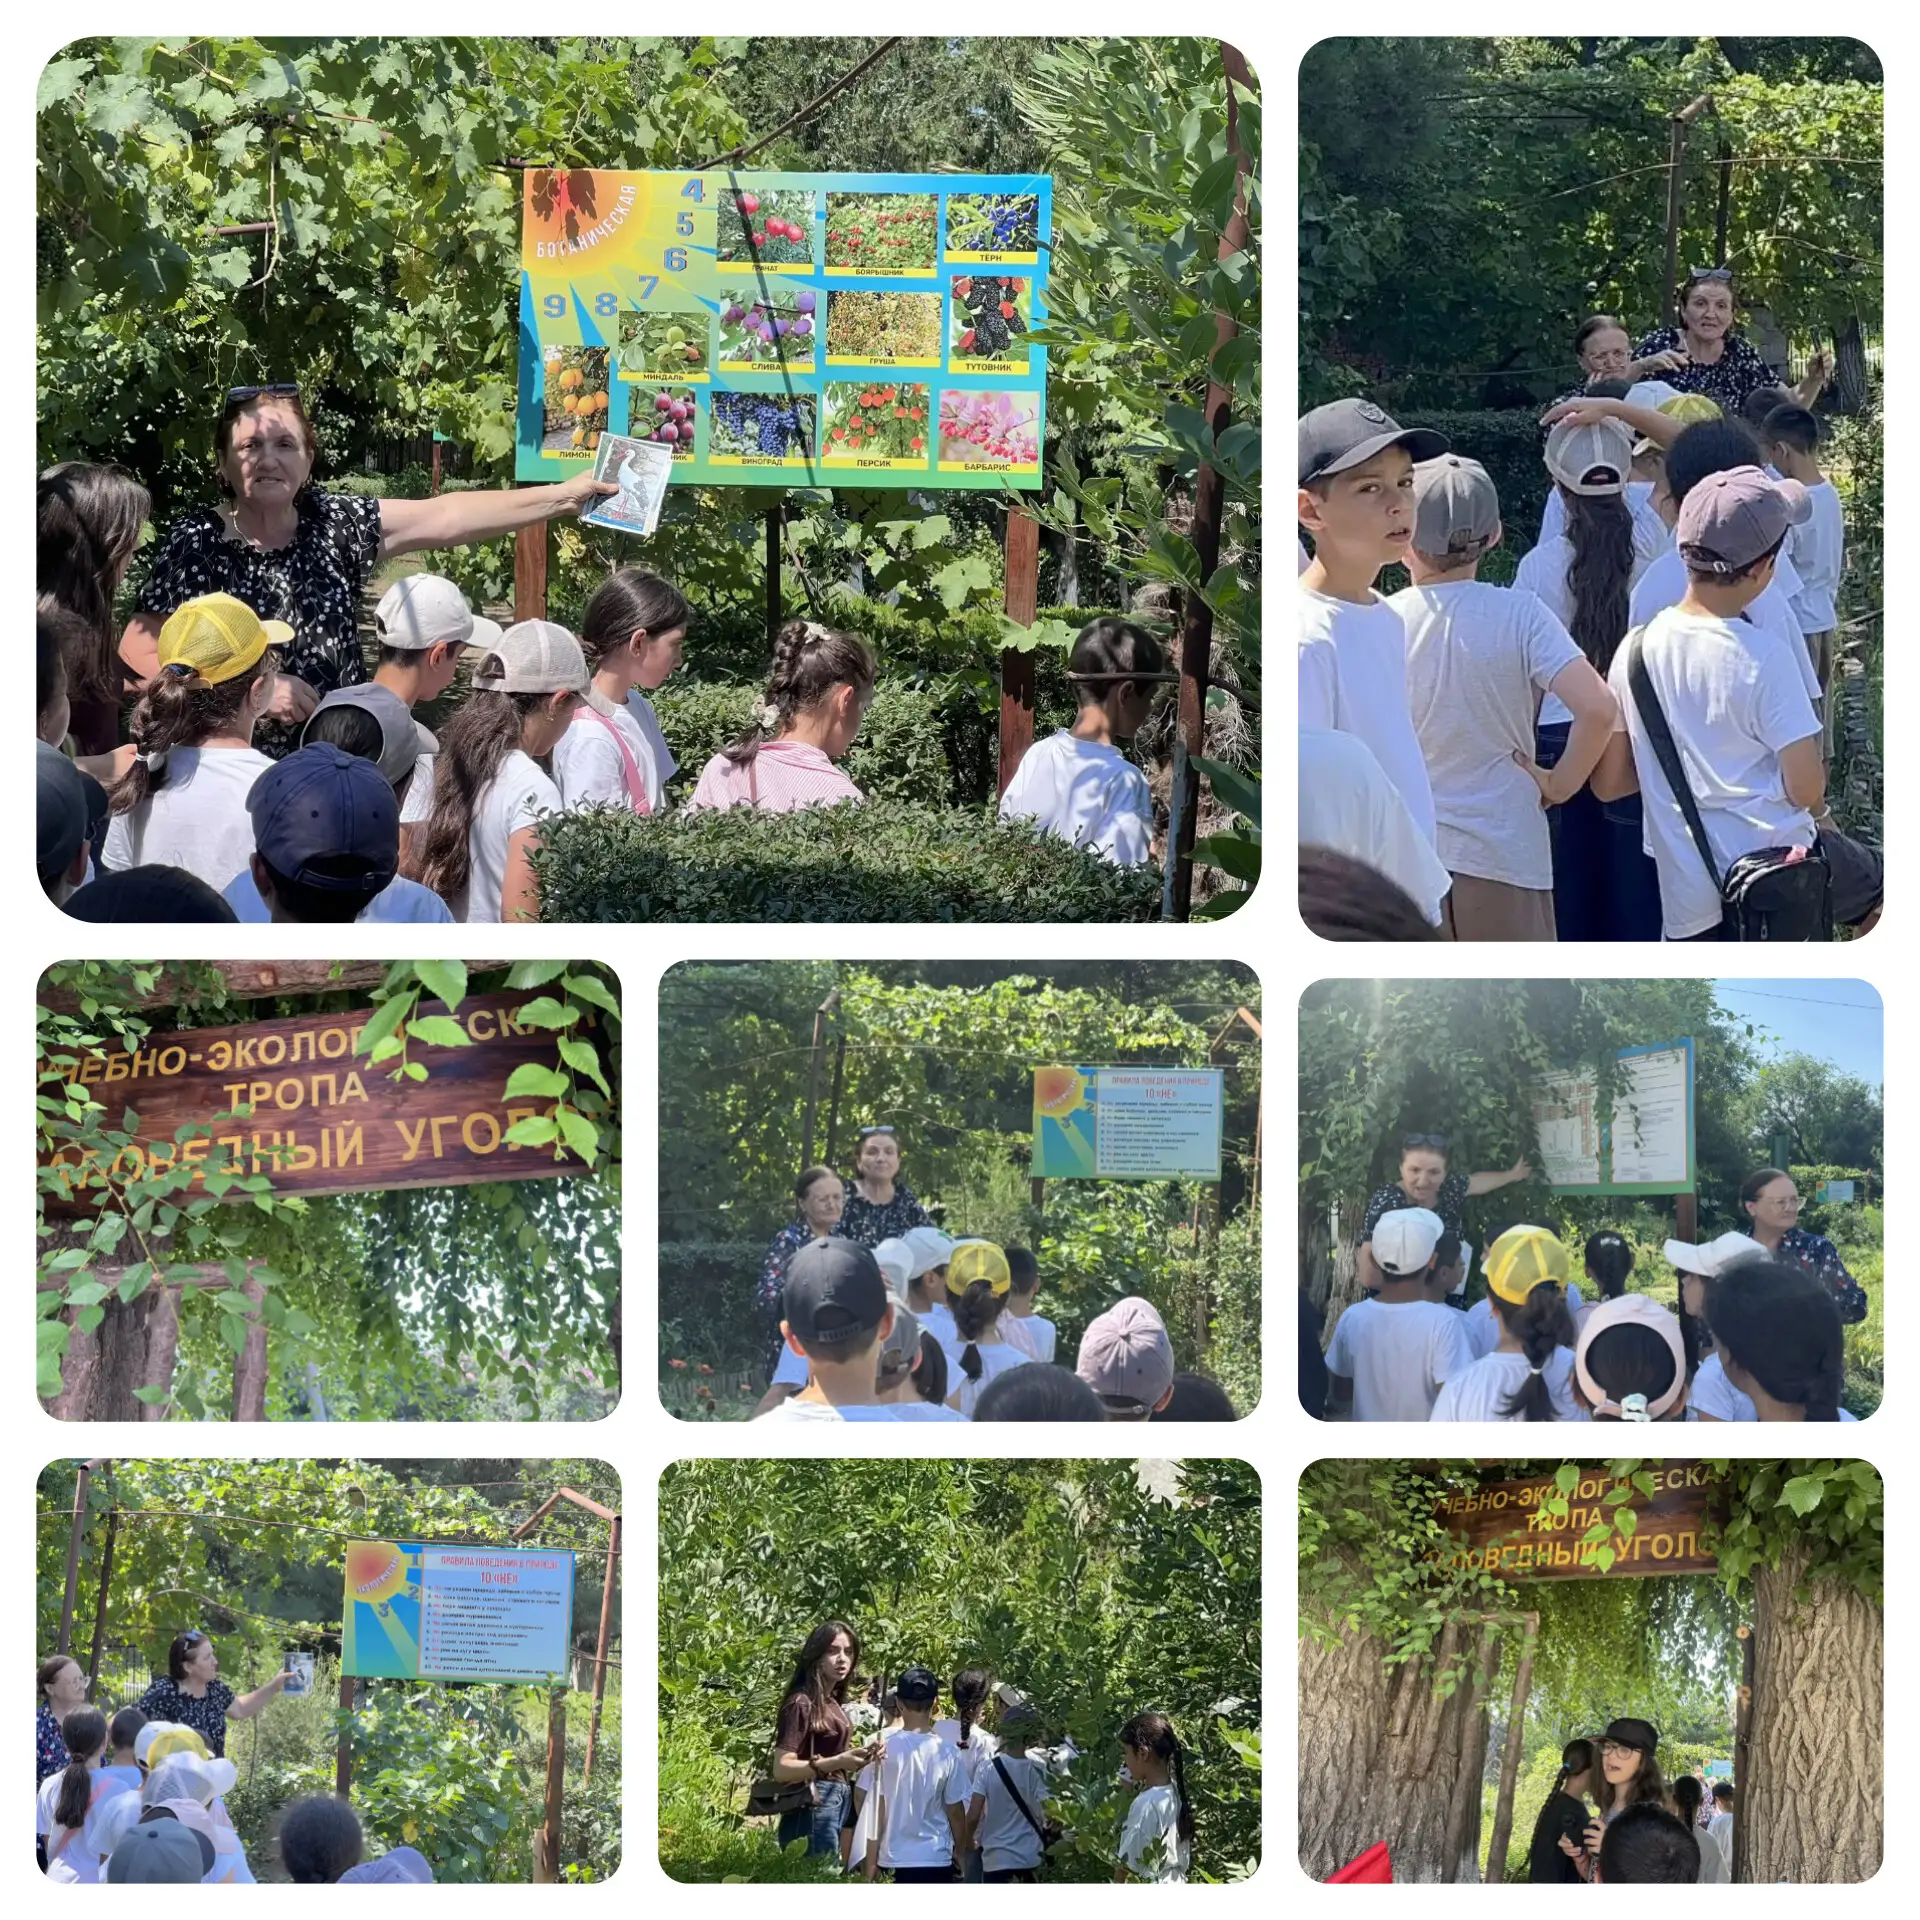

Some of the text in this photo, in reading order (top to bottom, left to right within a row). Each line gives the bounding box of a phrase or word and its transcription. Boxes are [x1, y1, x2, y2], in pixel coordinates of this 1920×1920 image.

[680, 178, 706, 203] 4
[536, 184, 637, 259] БОТАНИЧЕСКАЯ
[676, 212, 694, 237] 5
[663, 247, 688, 272] 6
[979, 254, 1002, 262] ТЕРН
[855, 268, 905, 277] БОЯРЫШНИК
[638, 275, 660, 300] 7
[543, 294, 567, 319] 9
[595, 293, 618, 317] 8
[751, 362, 781, 371] СЛИВА
[869, 357, 896, 366] ГРУША
[965, 363, 1012, 372] ТУТОВНИК
[643, 373, 684, 382] МИНДАЛЬ
[558, 451, 591, 459] ЛИМОН
[741, 458, 783, 467] ВИНОГРАД
[856, 459, 892, 467] ПЕРСИК
[964, 463, 1011, 472] БАРБАРИС
[223, 1071, 369, 1114] ТРОПА
[1146, 1088, 1155, 1099] 10
[1525, 1506, 1604, 1533] ТРОПА
[412, 1553, 419, 1566] 1
[441, 1555, 475, 1566] ПРАВИЛА
[475, 1557, 519, 1569] ПОВЕДЕНИЯ
[480, 1571, 518, 1585] 10 «НЕ»
[408, 1585, 420, 1600] 2
[378, 1602, 389, 1618] 3
